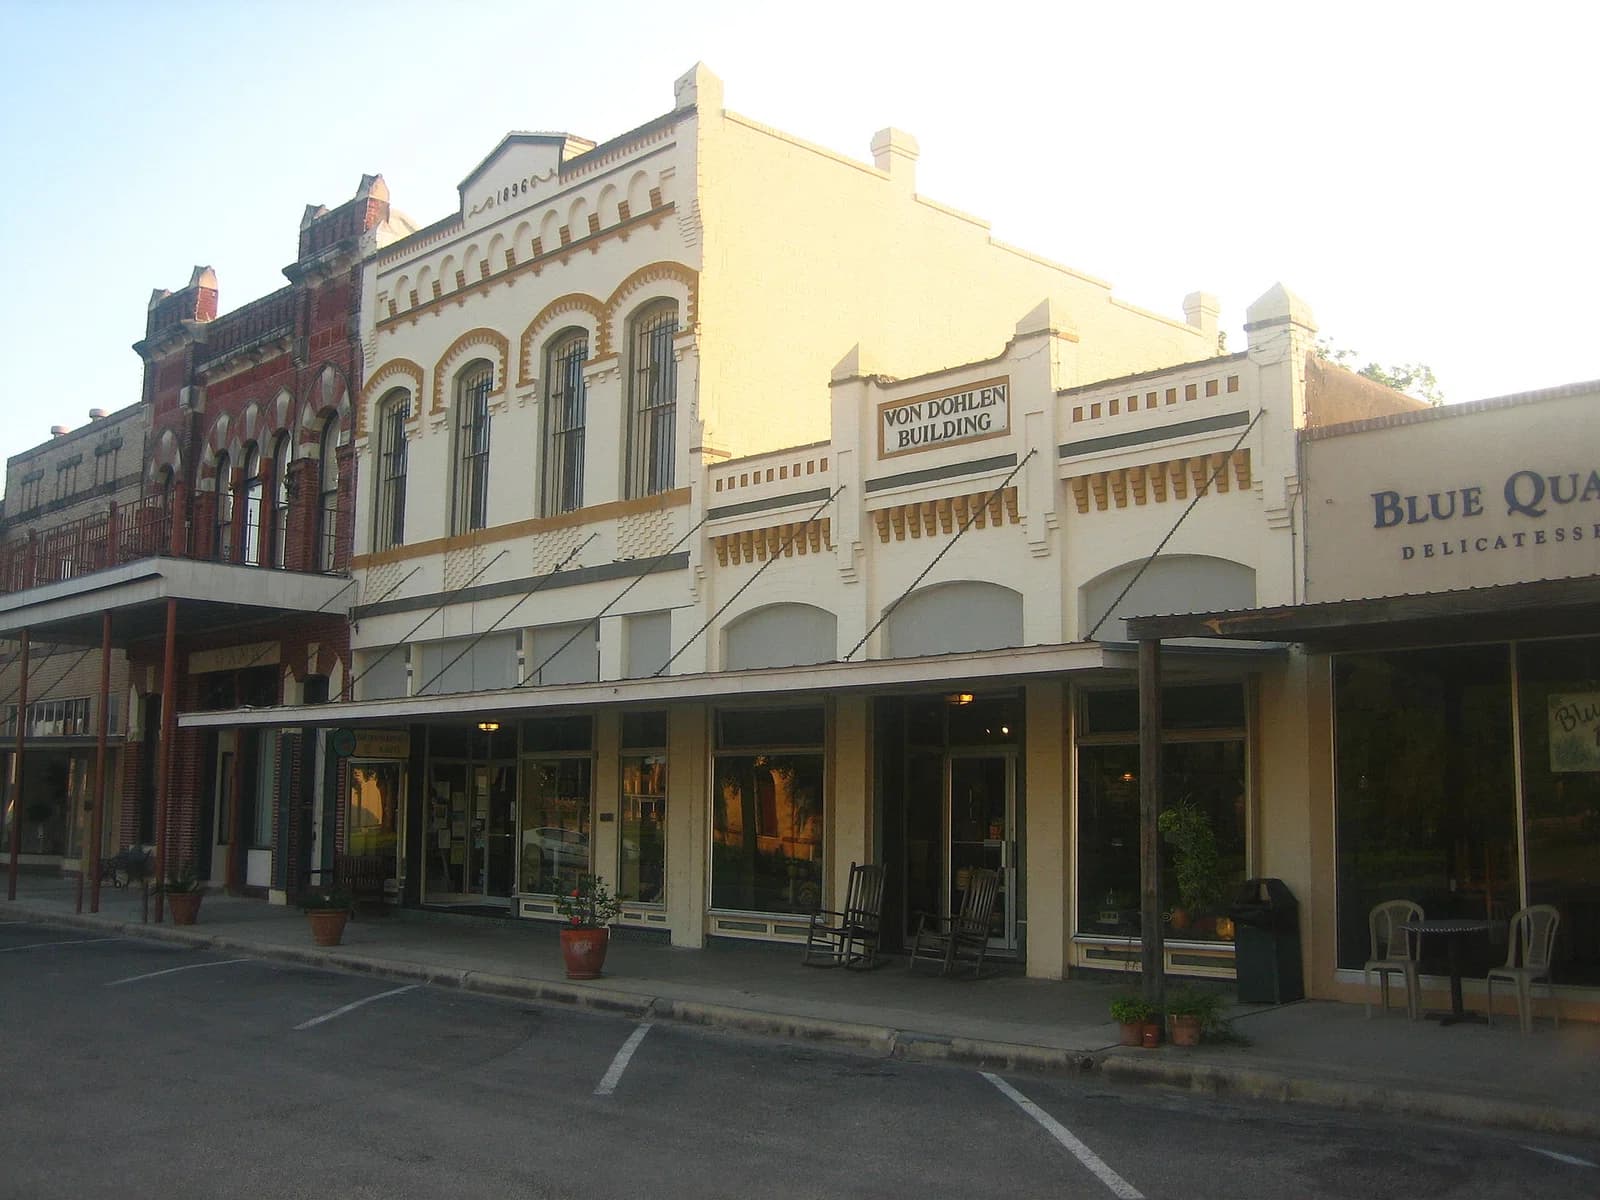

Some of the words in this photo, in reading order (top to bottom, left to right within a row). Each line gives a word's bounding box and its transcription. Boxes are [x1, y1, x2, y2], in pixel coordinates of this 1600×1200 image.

[496, 178, 527, 205] 1896
[885, 405, 922, 426] VON
[929, 385, 1006, 418] DOHLEN
[899, 413, 991, 447] BUILDING
